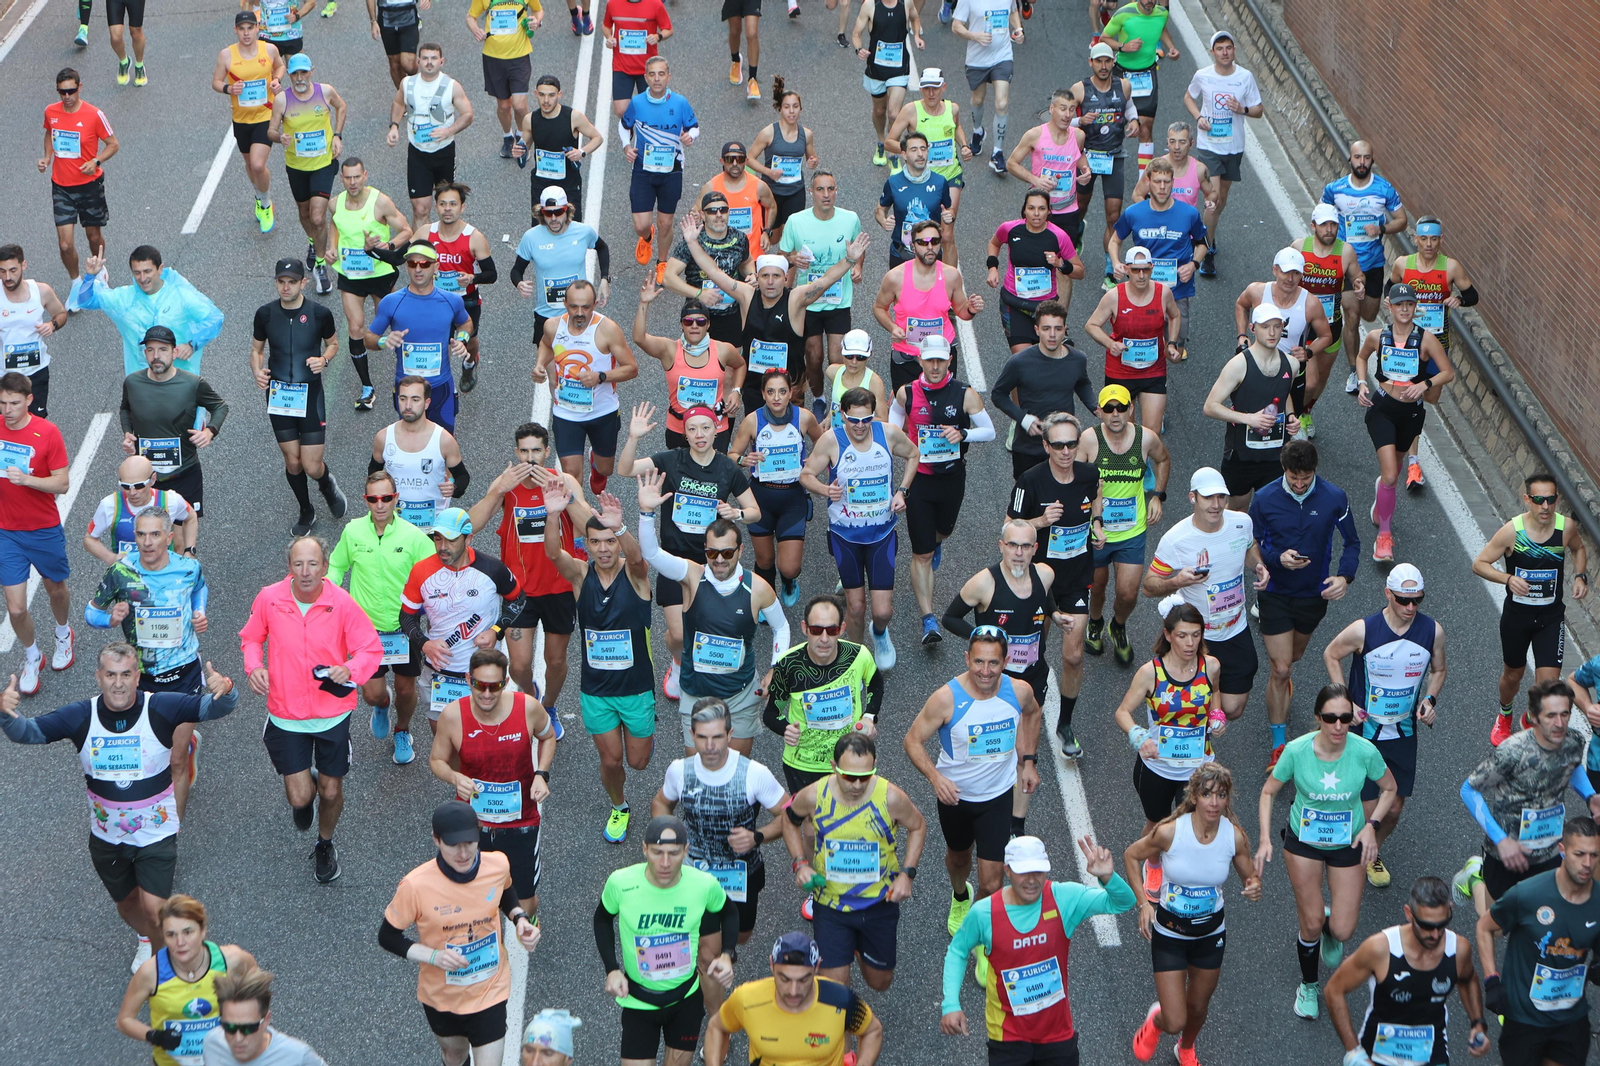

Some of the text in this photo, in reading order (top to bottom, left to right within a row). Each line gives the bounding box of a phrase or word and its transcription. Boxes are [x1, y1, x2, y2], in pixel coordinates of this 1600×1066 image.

[6, 444, 27, 454] ZURICH
[678, 486, 707, 497] MARATHON
[680, 480, 718, 494] CHICAGO
[1065, 525, 1087, 534] ZURICH
[1221, 578, 1242, 592] ZURICH
[599, 633, 625, 641] ZURICH
[819, 690, 846, 700] ZURICH
[821, 705, 837, 713] 4718
[985, 722, 1010, 732] ZURICH
[1175, 729, 1200, 737] ZURICH
[487, 783, 514, 793] ZURICH
[1308, 790, 1352, 802] SAYSKY
[1184, 889, 1211, 897] ZURICH
[637, 913, 688, 930] ELEVATE
[442, 922, 468, 932] Maratón
[654, 933, 683, 946] ZURICH
[1013, 933, 1047, 950] DATO
[465, 937, 491, 954] ZURICH
[655, 951, 672, 961] 8491
[448, 960, 498, 977] ANTONIO CAMPOS
[655, 961, 676, 970] JAVIER
[1021, 964, 1051, 978] ZURICH
[1026, 982, 1044, 994] 6489
[1023, 990, 1052, 1004] DATOMAN
[184, 1021, 216, 1031] ZURICH
[1398, 1028, 1427, 1038] ZURICH
